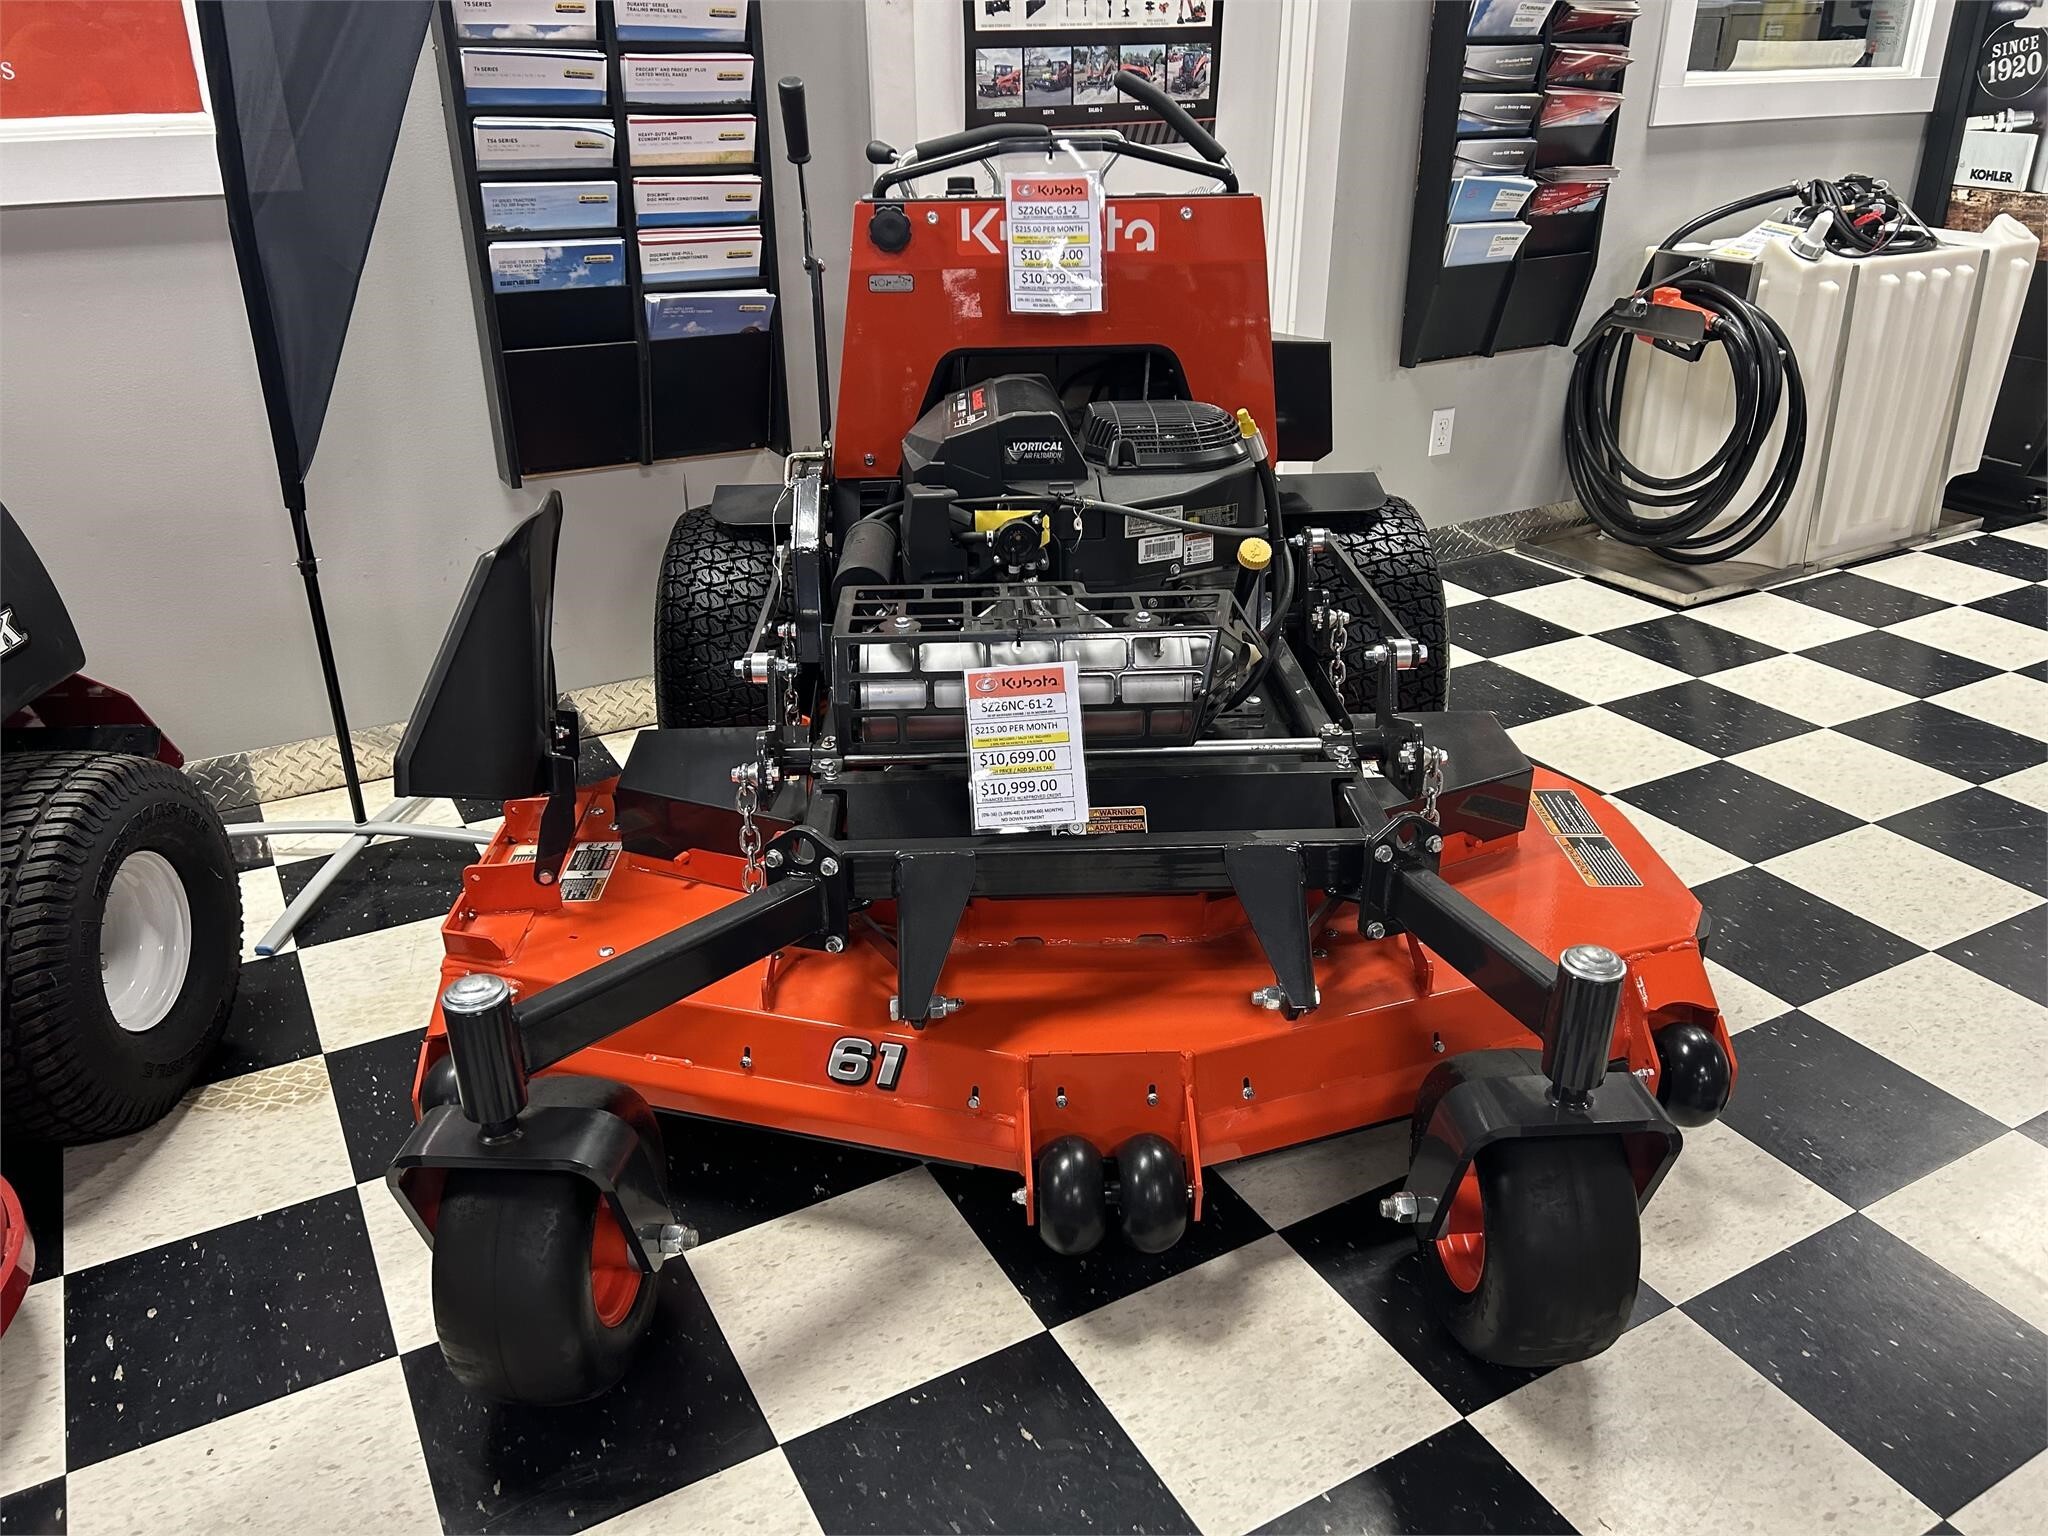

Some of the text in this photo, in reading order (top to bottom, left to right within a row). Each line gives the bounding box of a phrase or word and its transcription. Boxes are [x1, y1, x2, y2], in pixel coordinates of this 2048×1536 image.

[1992, 35, 2040, 58] SINCE
[1987, 52, 2042, 84] 1920
[1970, 168, 2014, 183] KOHLER
[1038, 185, 1083, 195] Kubota
[1018, 205, 1077, 215] SZ26NC-61-2
[962, 208, 1155, 253] Kta
[1012, 442, 1062, 451] VORTICAL
[1002, 675, 1058, 689] Kubota
[981, 698, 1053, 713] SZ26NC-61-2
[975, 722, 1058, 736] $215.00 PER MONTH
[980, 749, 1056, 768] $10,699.00
[981, 779, 1057, 797] $10,999.00
[827, 1036, 908, 1090] 61
